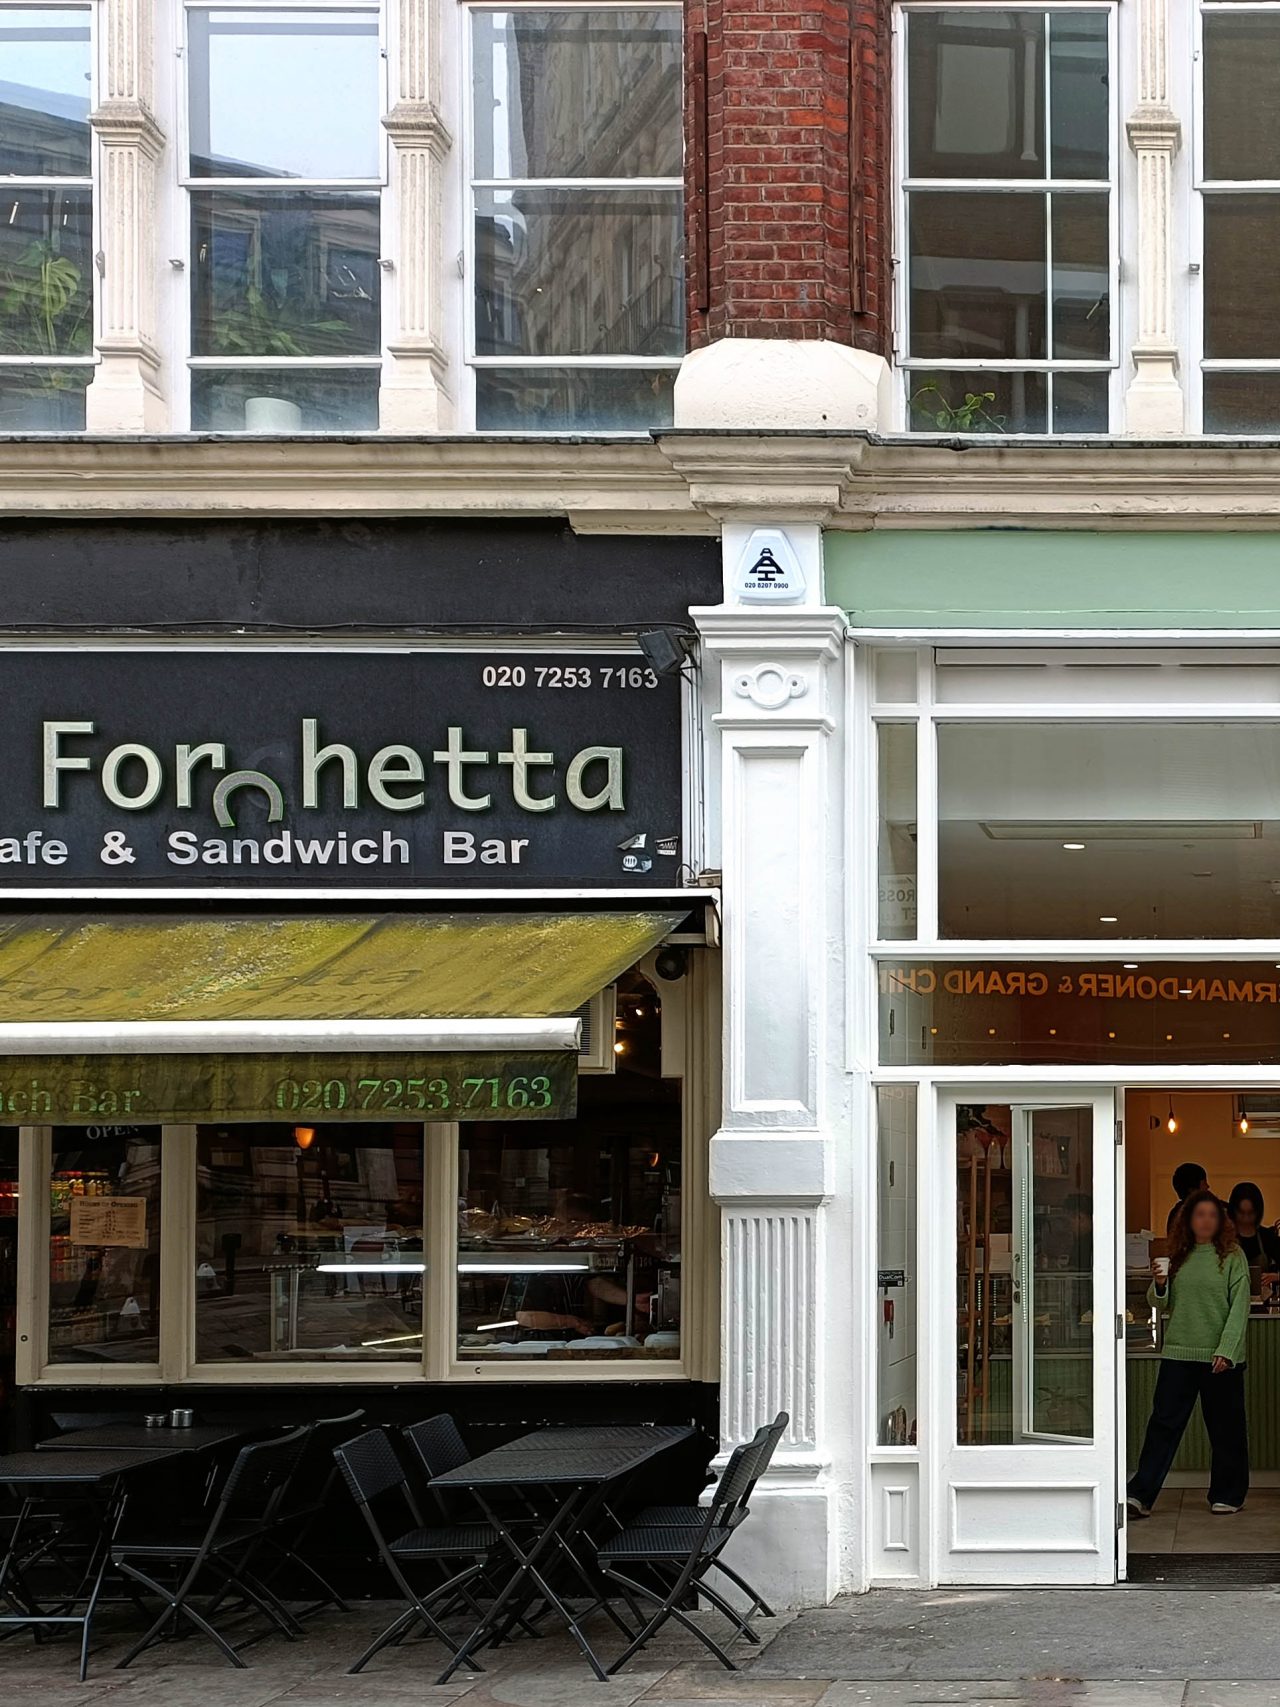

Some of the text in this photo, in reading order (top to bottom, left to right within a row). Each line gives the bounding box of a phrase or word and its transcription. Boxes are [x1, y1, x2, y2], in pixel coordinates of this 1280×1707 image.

[482, 665, 659, 690] 020 7253 7163
[100, 832, 137, 865] &
[167, 830, 411, 866] Sandwich
[443, 831, 530, 865] Bar
[69, 1080, 142, 1114] Bar
[276, 1075, 553, 1111] 020 7253 7163
